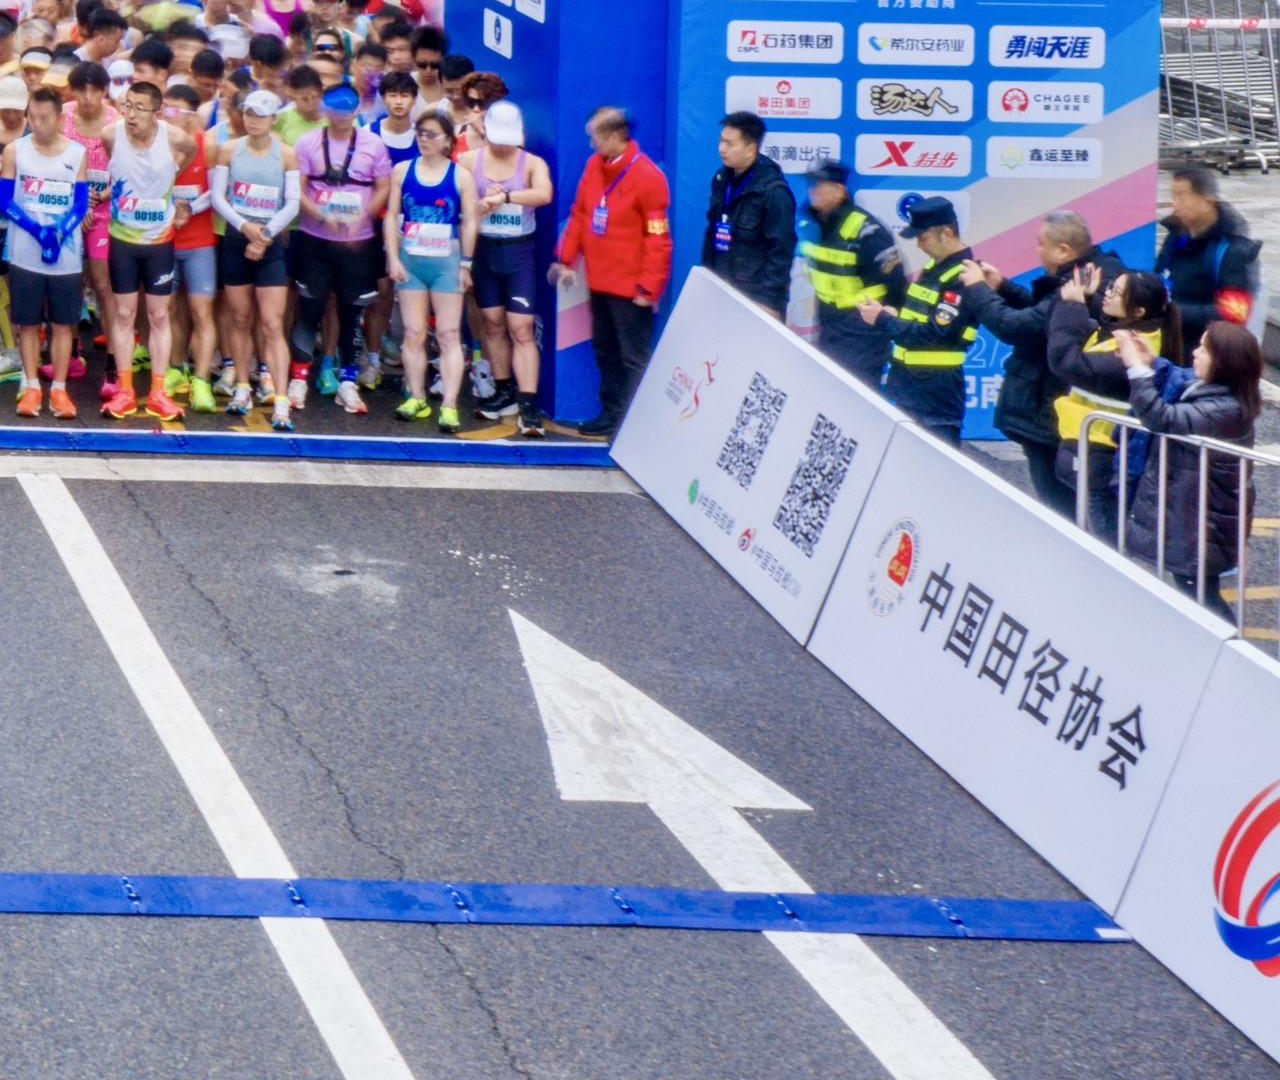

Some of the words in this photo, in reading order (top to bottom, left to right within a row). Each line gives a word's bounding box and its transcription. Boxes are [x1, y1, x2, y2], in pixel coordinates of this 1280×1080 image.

[763, 33, 833, 50] 石药集团
[890, 37, 966, 53] 希尔安药业
[1004, 35, 1092, 60] 勇闯天涯
[870, 84, 959, 117] 汤达人
[1033, 94, 1090, 103] CHAGEE
[765, 146, 831, 161] 滴滴出行
[911, 152, 959, 168] 特步
[38, 193, 69, 206] 00563
[134, 210, 164, 222] 00186
[918, 563, 1147, 792] 中国田径协会
